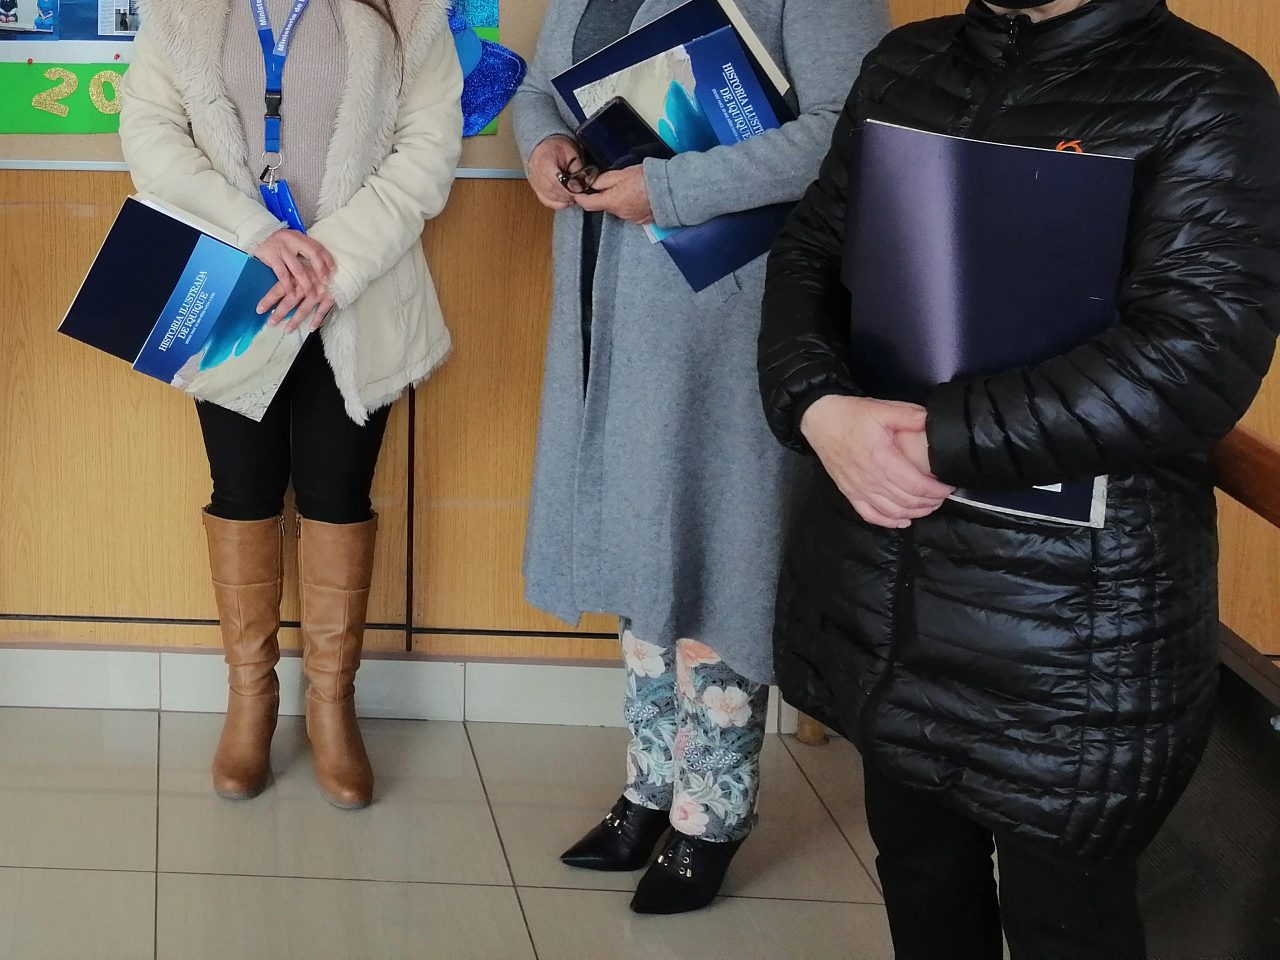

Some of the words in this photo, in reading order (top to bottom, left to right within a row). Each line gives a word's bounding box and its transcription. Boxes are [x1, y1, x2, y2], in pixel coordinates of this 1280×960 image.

[278, 13, 297, 52] Ministerio
[294, 3, 303, 13] de
[720, 87, 733, 102] DE
[722, 62, 749, 105] HISTORIA
[726, 101, 751, 141] IQUIQUE
[158, 315, 184, 352] HISTORIA
[179, 271, 208, 315] ILUSTRADA
[178, 326, 189, 340] DE
[184, 292, 209, 328] IQUIQUE
